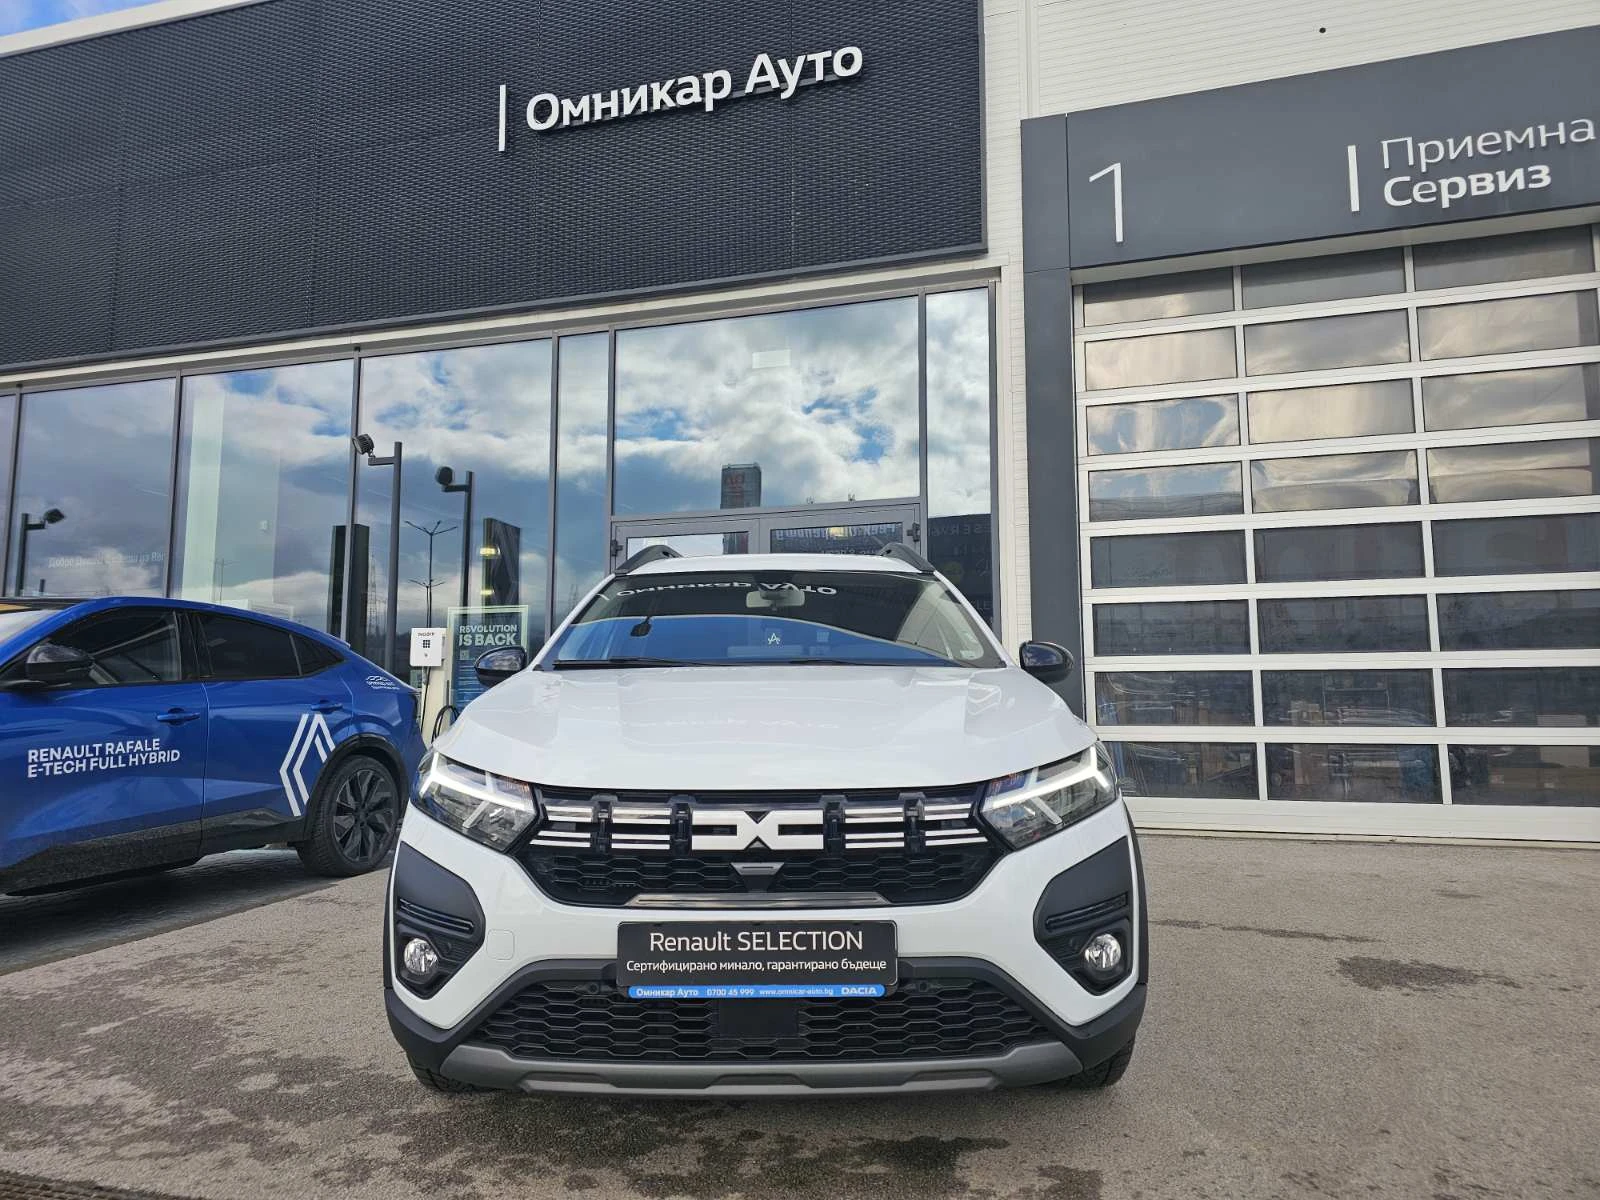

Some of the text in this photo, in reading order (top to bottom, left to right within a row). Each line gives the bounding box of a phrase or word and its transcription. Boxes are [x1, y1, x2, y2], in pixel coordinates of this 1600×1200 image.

[526, 45, 863, 131] Омникар Ауто
[1381, 118, 1596, 173] Приемна
[1383, 164, 1552, 209] Сервиз
[1089, 162, 1124, 243] 1
[458, 632, 517, 647] IS BACK
[27, 738, 161, 763] RENAULT RAFALE
[27, 750, 181, 778] E-TECH FULL HYBRID
[649, 930, 863, 952] Renault SELECTION
[626, 958, 887, 973] Сертифицирано минало, гарантирано бъдеще
[635, 988, 676, 998] Омникар
[677, 988, 699, 998] Ауто
[841, 986, 878, 996] DACIA
